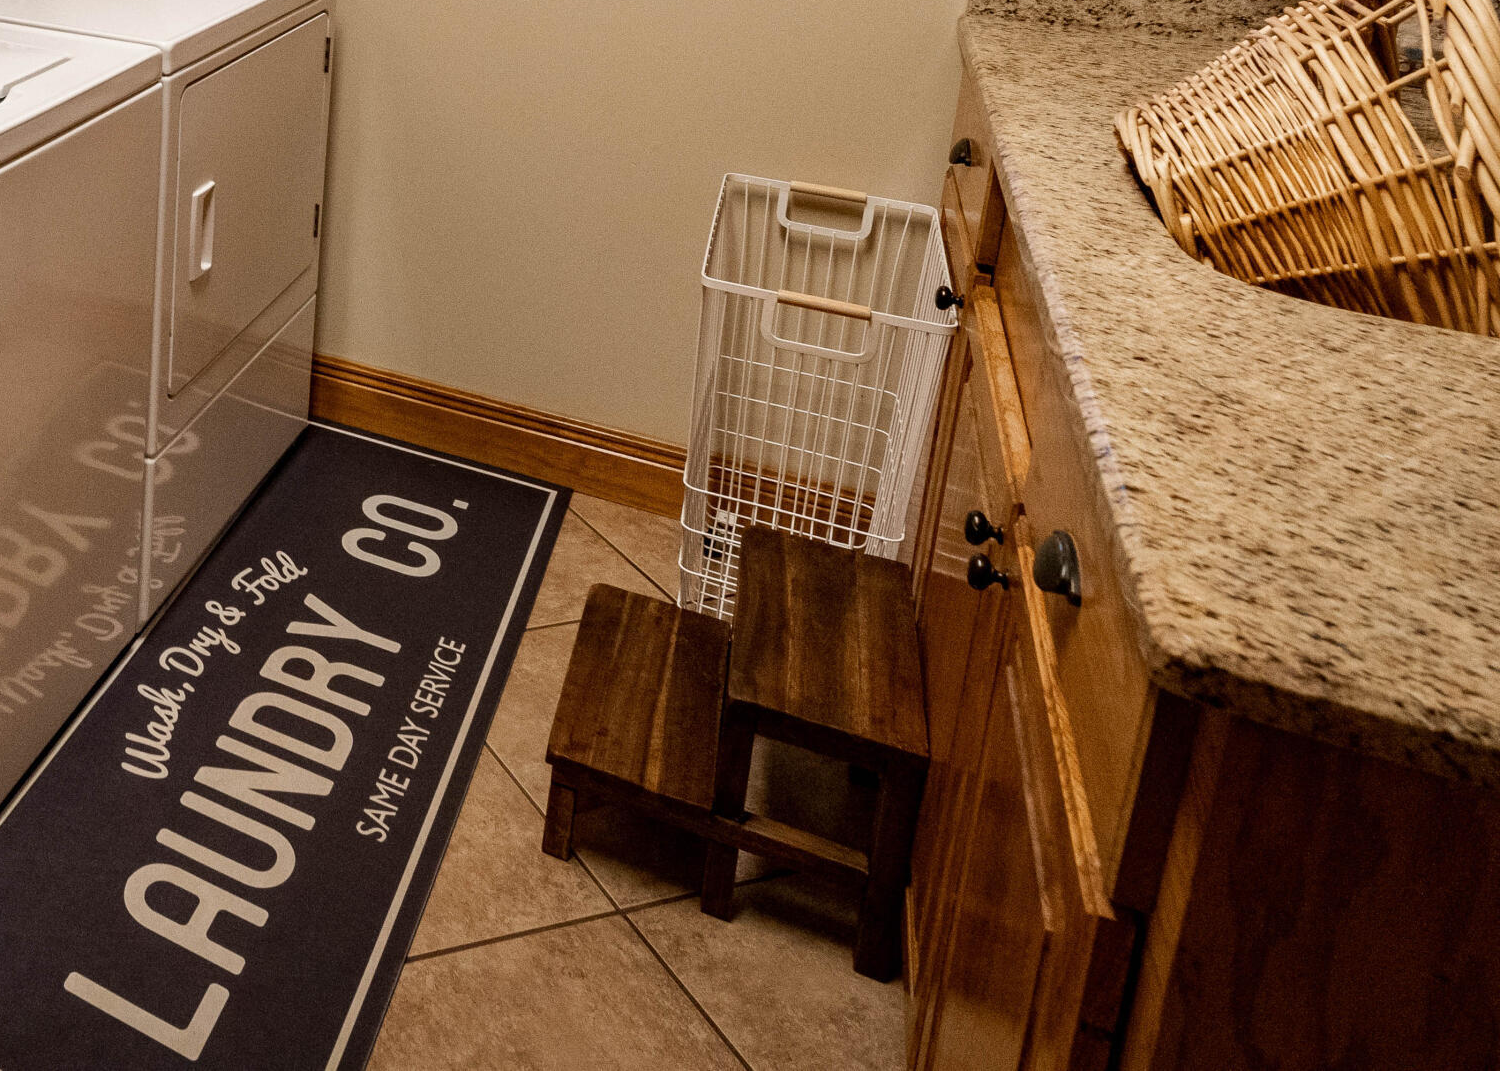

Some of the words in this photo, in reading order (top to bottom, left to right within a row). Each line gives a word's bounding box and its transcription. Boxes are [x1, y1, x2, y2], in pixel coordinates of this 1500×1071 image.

[63, 592, 402, 1062] LAUNDRY
[341, 494, 469, 578] CO.
[121, 682, 196, 779] Wash,
[159, 626, 241, 677] Dry
[205, 600, 246, 626] &
[231, 551, 308, 606] Fold
[355, 768, 411, 843] SAME
[387, 716, 430, 770] DAY
[410, 636, 466, 719] SERVICE
